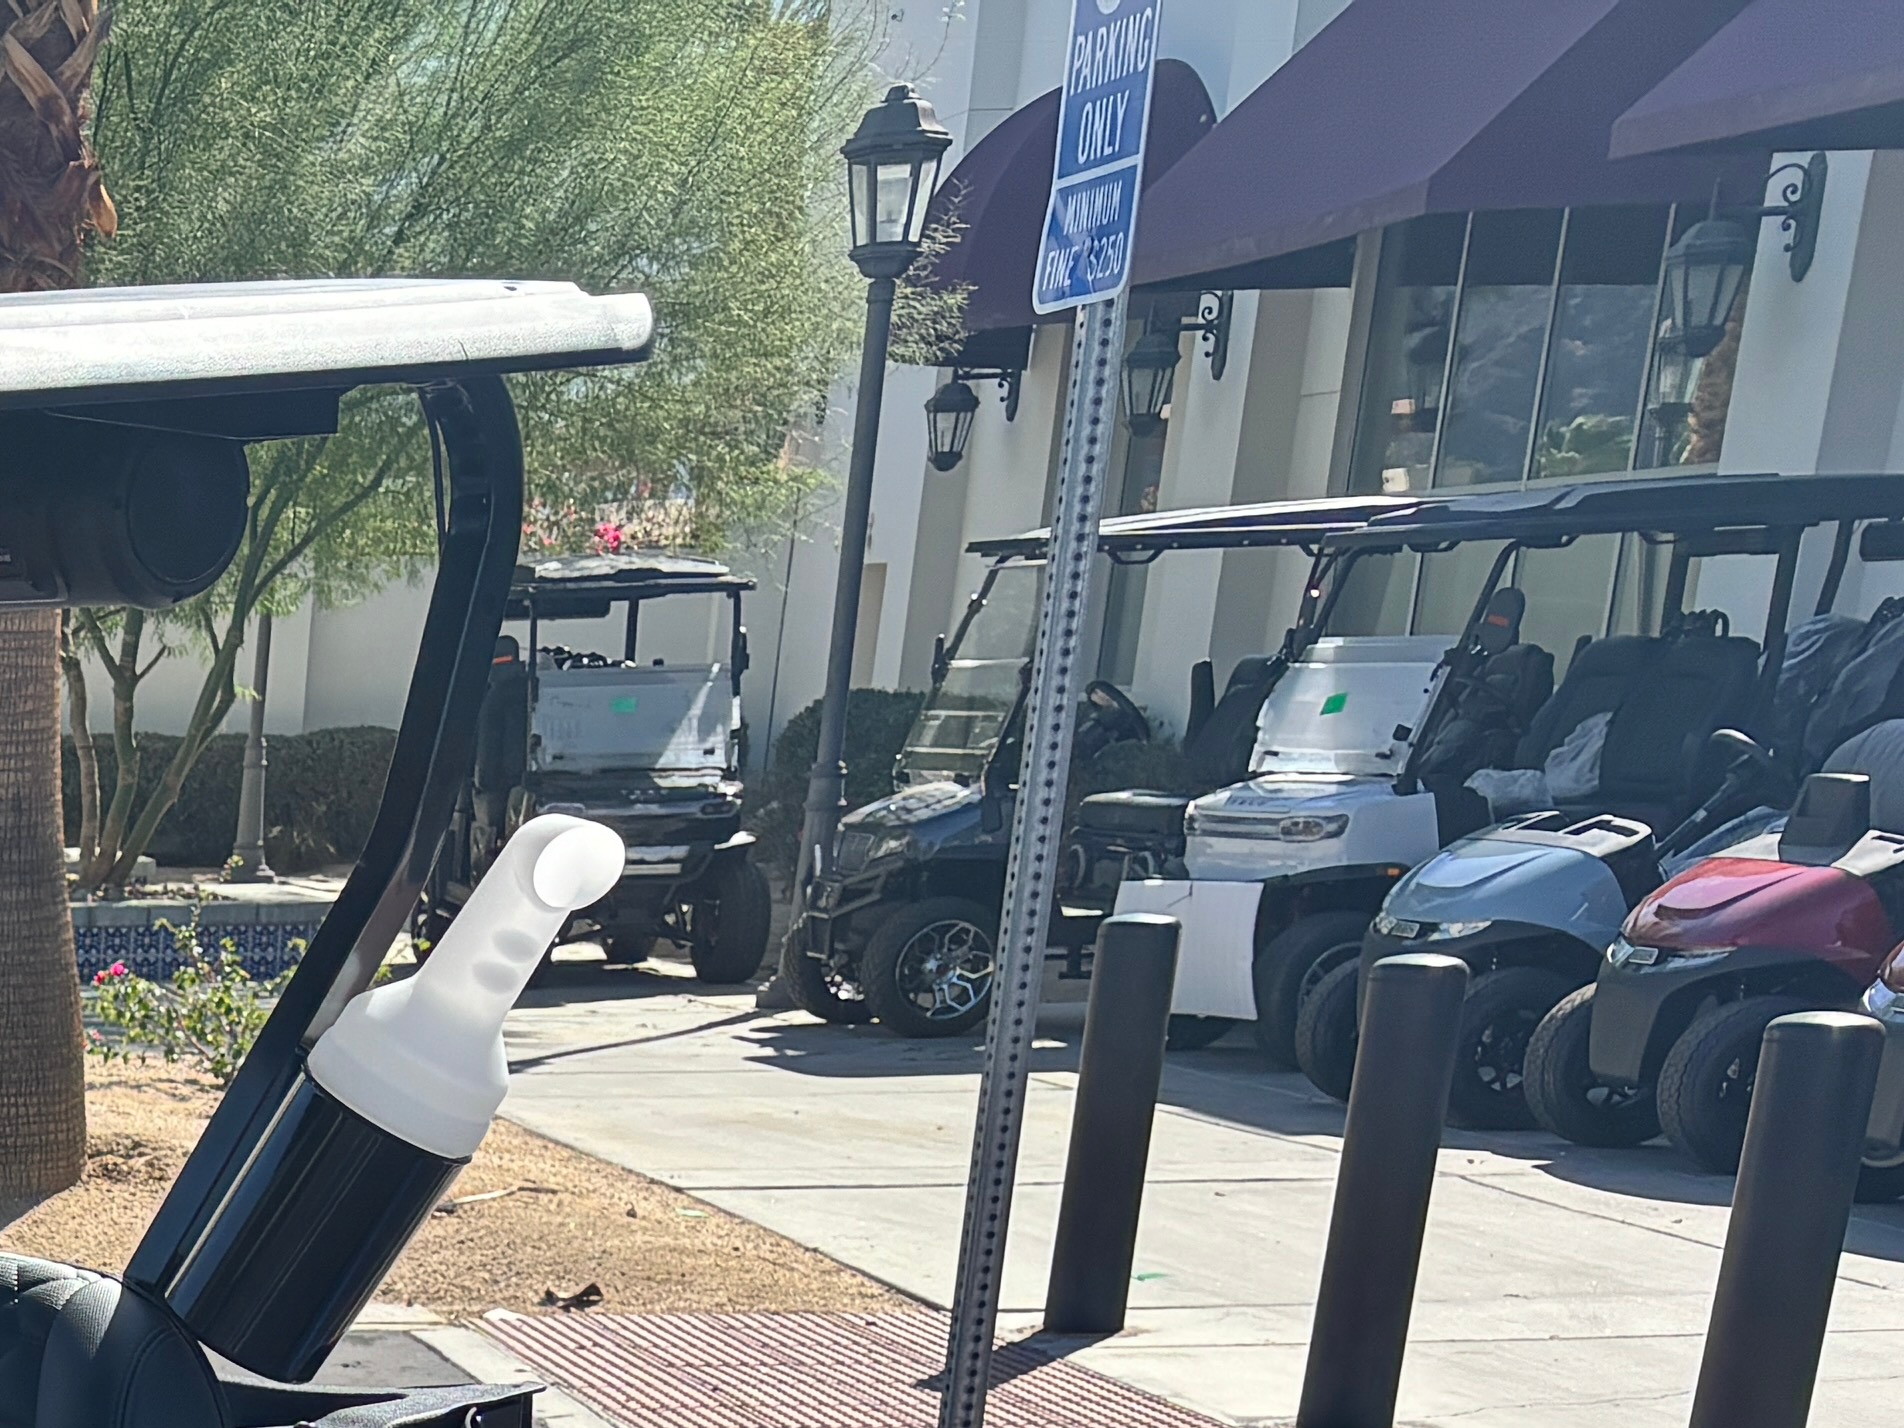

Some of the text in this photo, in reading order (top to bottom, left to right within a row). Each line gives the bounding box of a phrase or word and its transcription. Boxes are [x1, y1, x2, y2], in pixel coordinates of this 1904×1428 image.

[1069, 7, 1153, 96] PARKING
[1077, 90, 1130, 165] ONLY
[1063, 180, 1123, 236] MINIMUM
[1042, 232, 1125, 291] FINE $250
